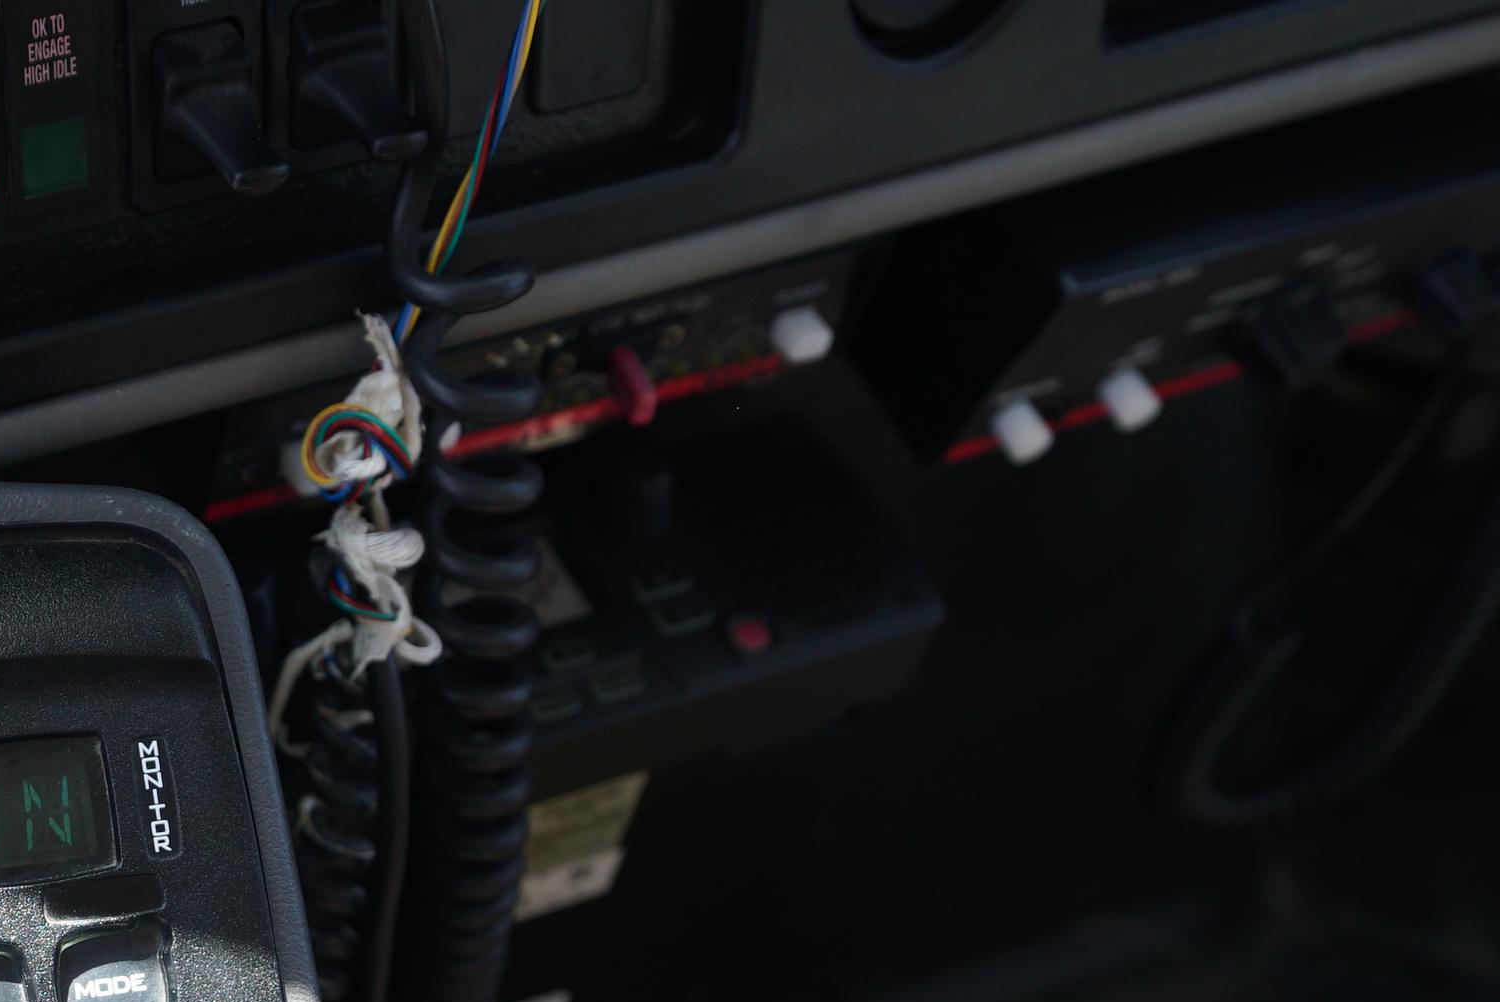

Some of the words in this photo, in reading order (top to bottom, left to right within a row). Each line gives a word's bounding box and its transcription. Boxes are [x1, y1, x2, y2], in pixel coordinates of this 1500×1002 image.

[31, 17, 49, 39] OK
[50, 13, 65, 34] TO
[28, 35, 71, 62] ENGAGE
[24, 63, 50, 86] HIGH
[53, 57, 77, 80] IDLE
[137, 740, 173, 853] MONITOR
[74, 973, 147, 999] MODE
